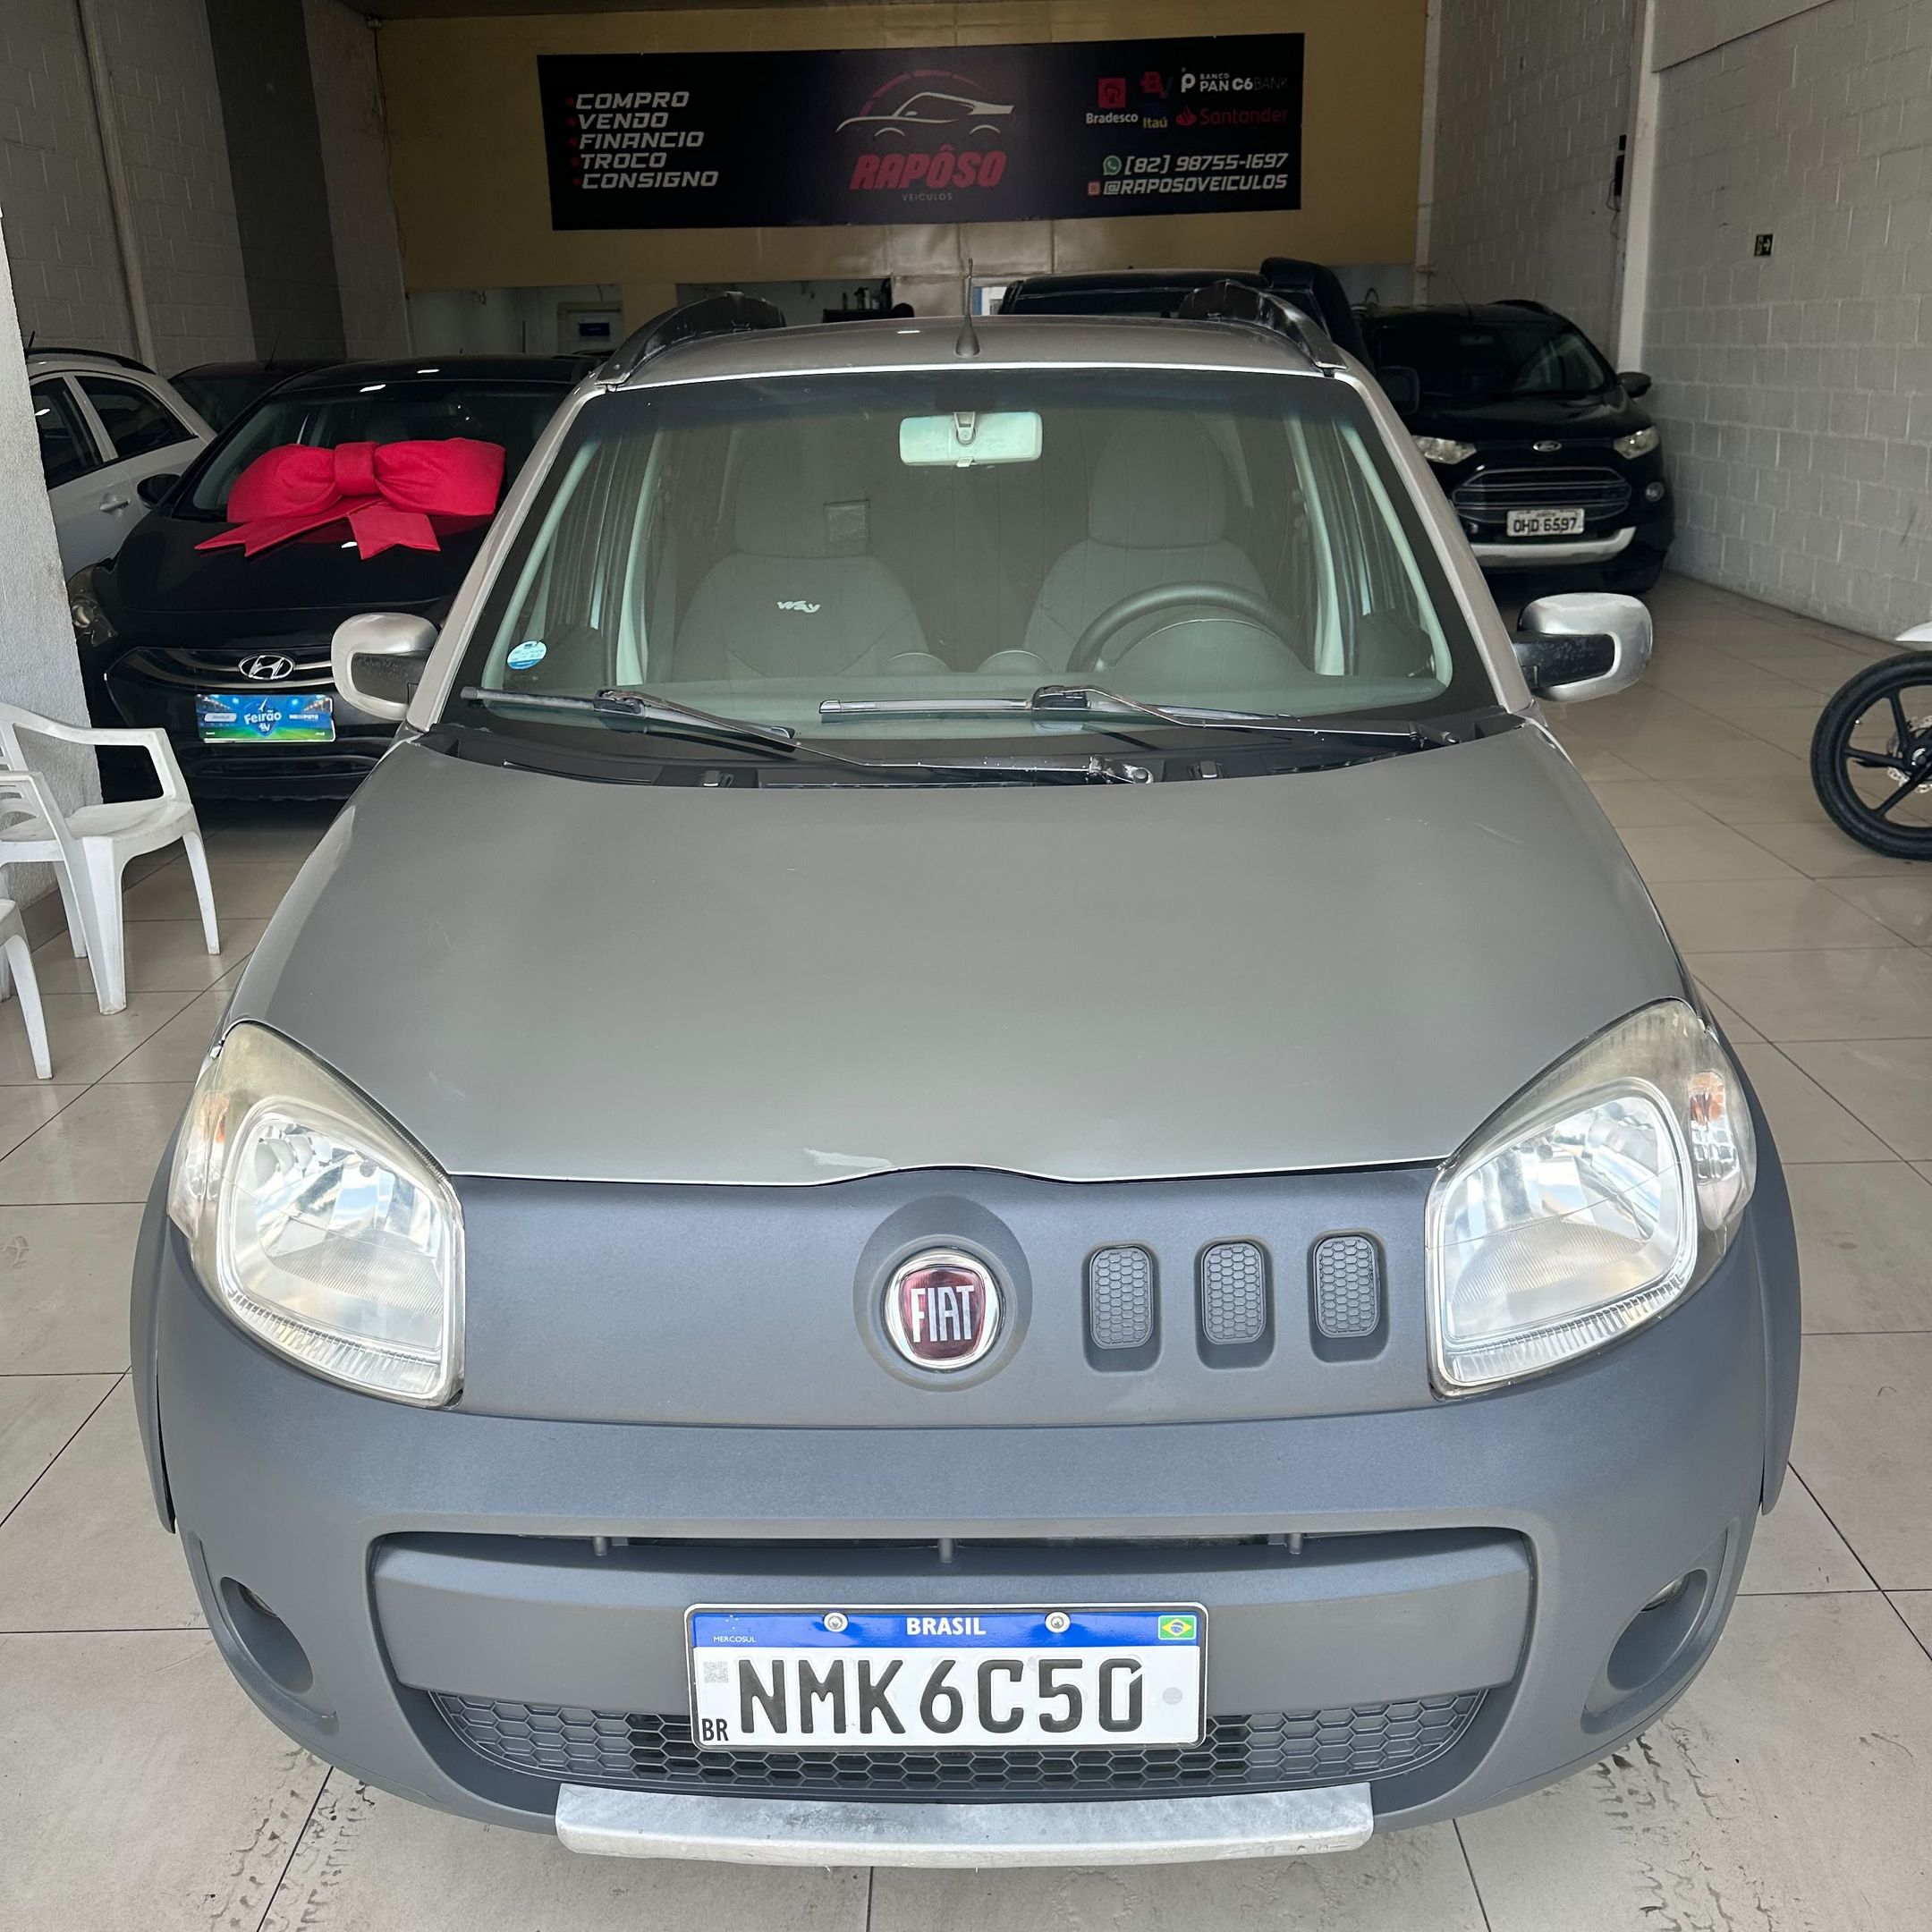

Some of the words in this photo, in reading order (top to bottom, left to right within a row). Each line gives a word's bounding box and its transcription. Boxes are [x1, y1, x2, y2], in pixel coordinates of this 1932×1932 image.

[1199, 80, 1229, 92] PAN
[576, 91, 690, 110] COMPRO
[578, 113, 669, 130] VENDO
[1086, 113, 1139, 124] Bradesco
[1143, 117, 1167, 129] Itaú
[1199, 107, 1288, 126] Santander
[579, 131, 704, 149] FINANCIO
[580, 152, 667, 169] TROCO
[850, 144, 1007, 190] RAPÔSO
[1174, 152, 1289, 172] 98755-1697
[581, 171, 718, 189] CONSIGNO
[1103, 174, 1289, 195] @RAPOSOVEICULOS
[902, 192, 953, 201] VEICULOS
[244, 710, 282, 725] Feirão
[911, 1284, 975, 1343] FIAT
[906, 1617, 987, 1637] BRASIL
[713, 1635, 757, 1643] MERCOSUL
[738, 1657, 1144, 1735] NMK6C50
[701, 1718, 729, 1741] BR
